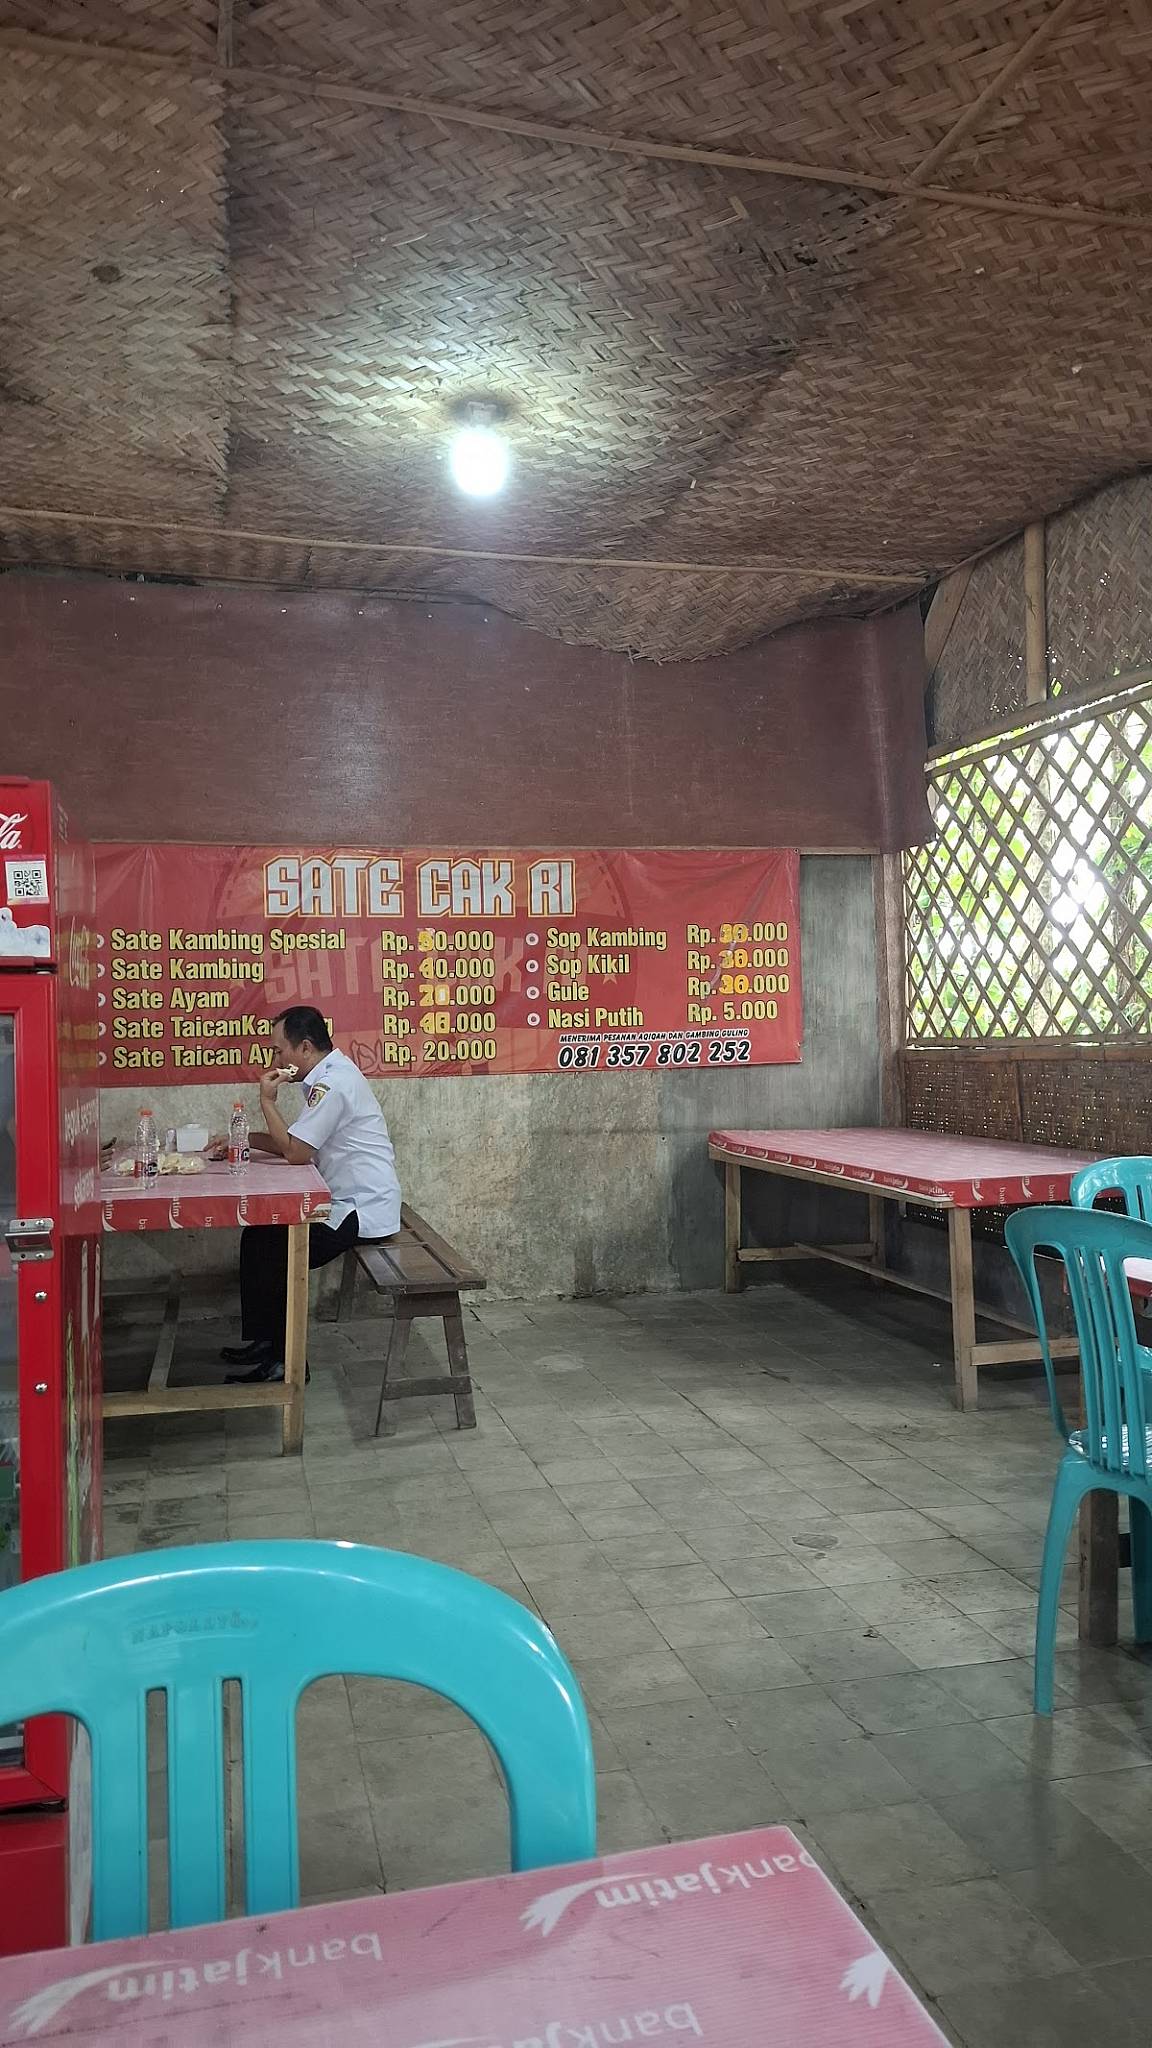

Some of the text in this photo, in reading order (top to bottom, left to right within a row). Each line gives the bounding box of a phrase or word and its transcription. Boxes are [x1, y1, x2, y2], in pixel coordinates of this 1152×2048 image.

[263, 855, 577, 918] SATE CAK RI
[111, 928, 346, 954] Sate Kambing Spesial
[381, 930, 415, 955] Rp.
[546, 927, 668, 951] Sop Kambing
[687, 924, 716, 948] Rp.
[111, 958, 264, 983] Sate Kambing
[382, 958, 415, 983] Rp.
[546, 955, 582, 979] Sop
[587, 954, 630, 975] Kikil
[687, 950, 716, 974] Rp.
[111, 987, 230, 1012] Sate Ayam
[382, 986, 416, 1011] Rp.
[547, 981, 590, 1002] Gule
[687, 976, 717, 1000] Rp.
[383, 1013, 416, 1038] Rp.
[547, 1006, 645, 1028] Nasi Putih
[687, 1000, 778, 1026] Rp. 5.000
[112, 1014, 334, 1039] Sate TaicanKa
[560, 1033, 601, 1043] MENERIMA
[668, 1031, 683, 1040] DAN
[113, 1044, 274, 1069] Sate Taican Ay
[384, 1039, 497, 1067] Rp. 20.000
[558, 1040, 751, 1068] 081 357 802 252
[106, 1932, 384, 2001] bankjatim
